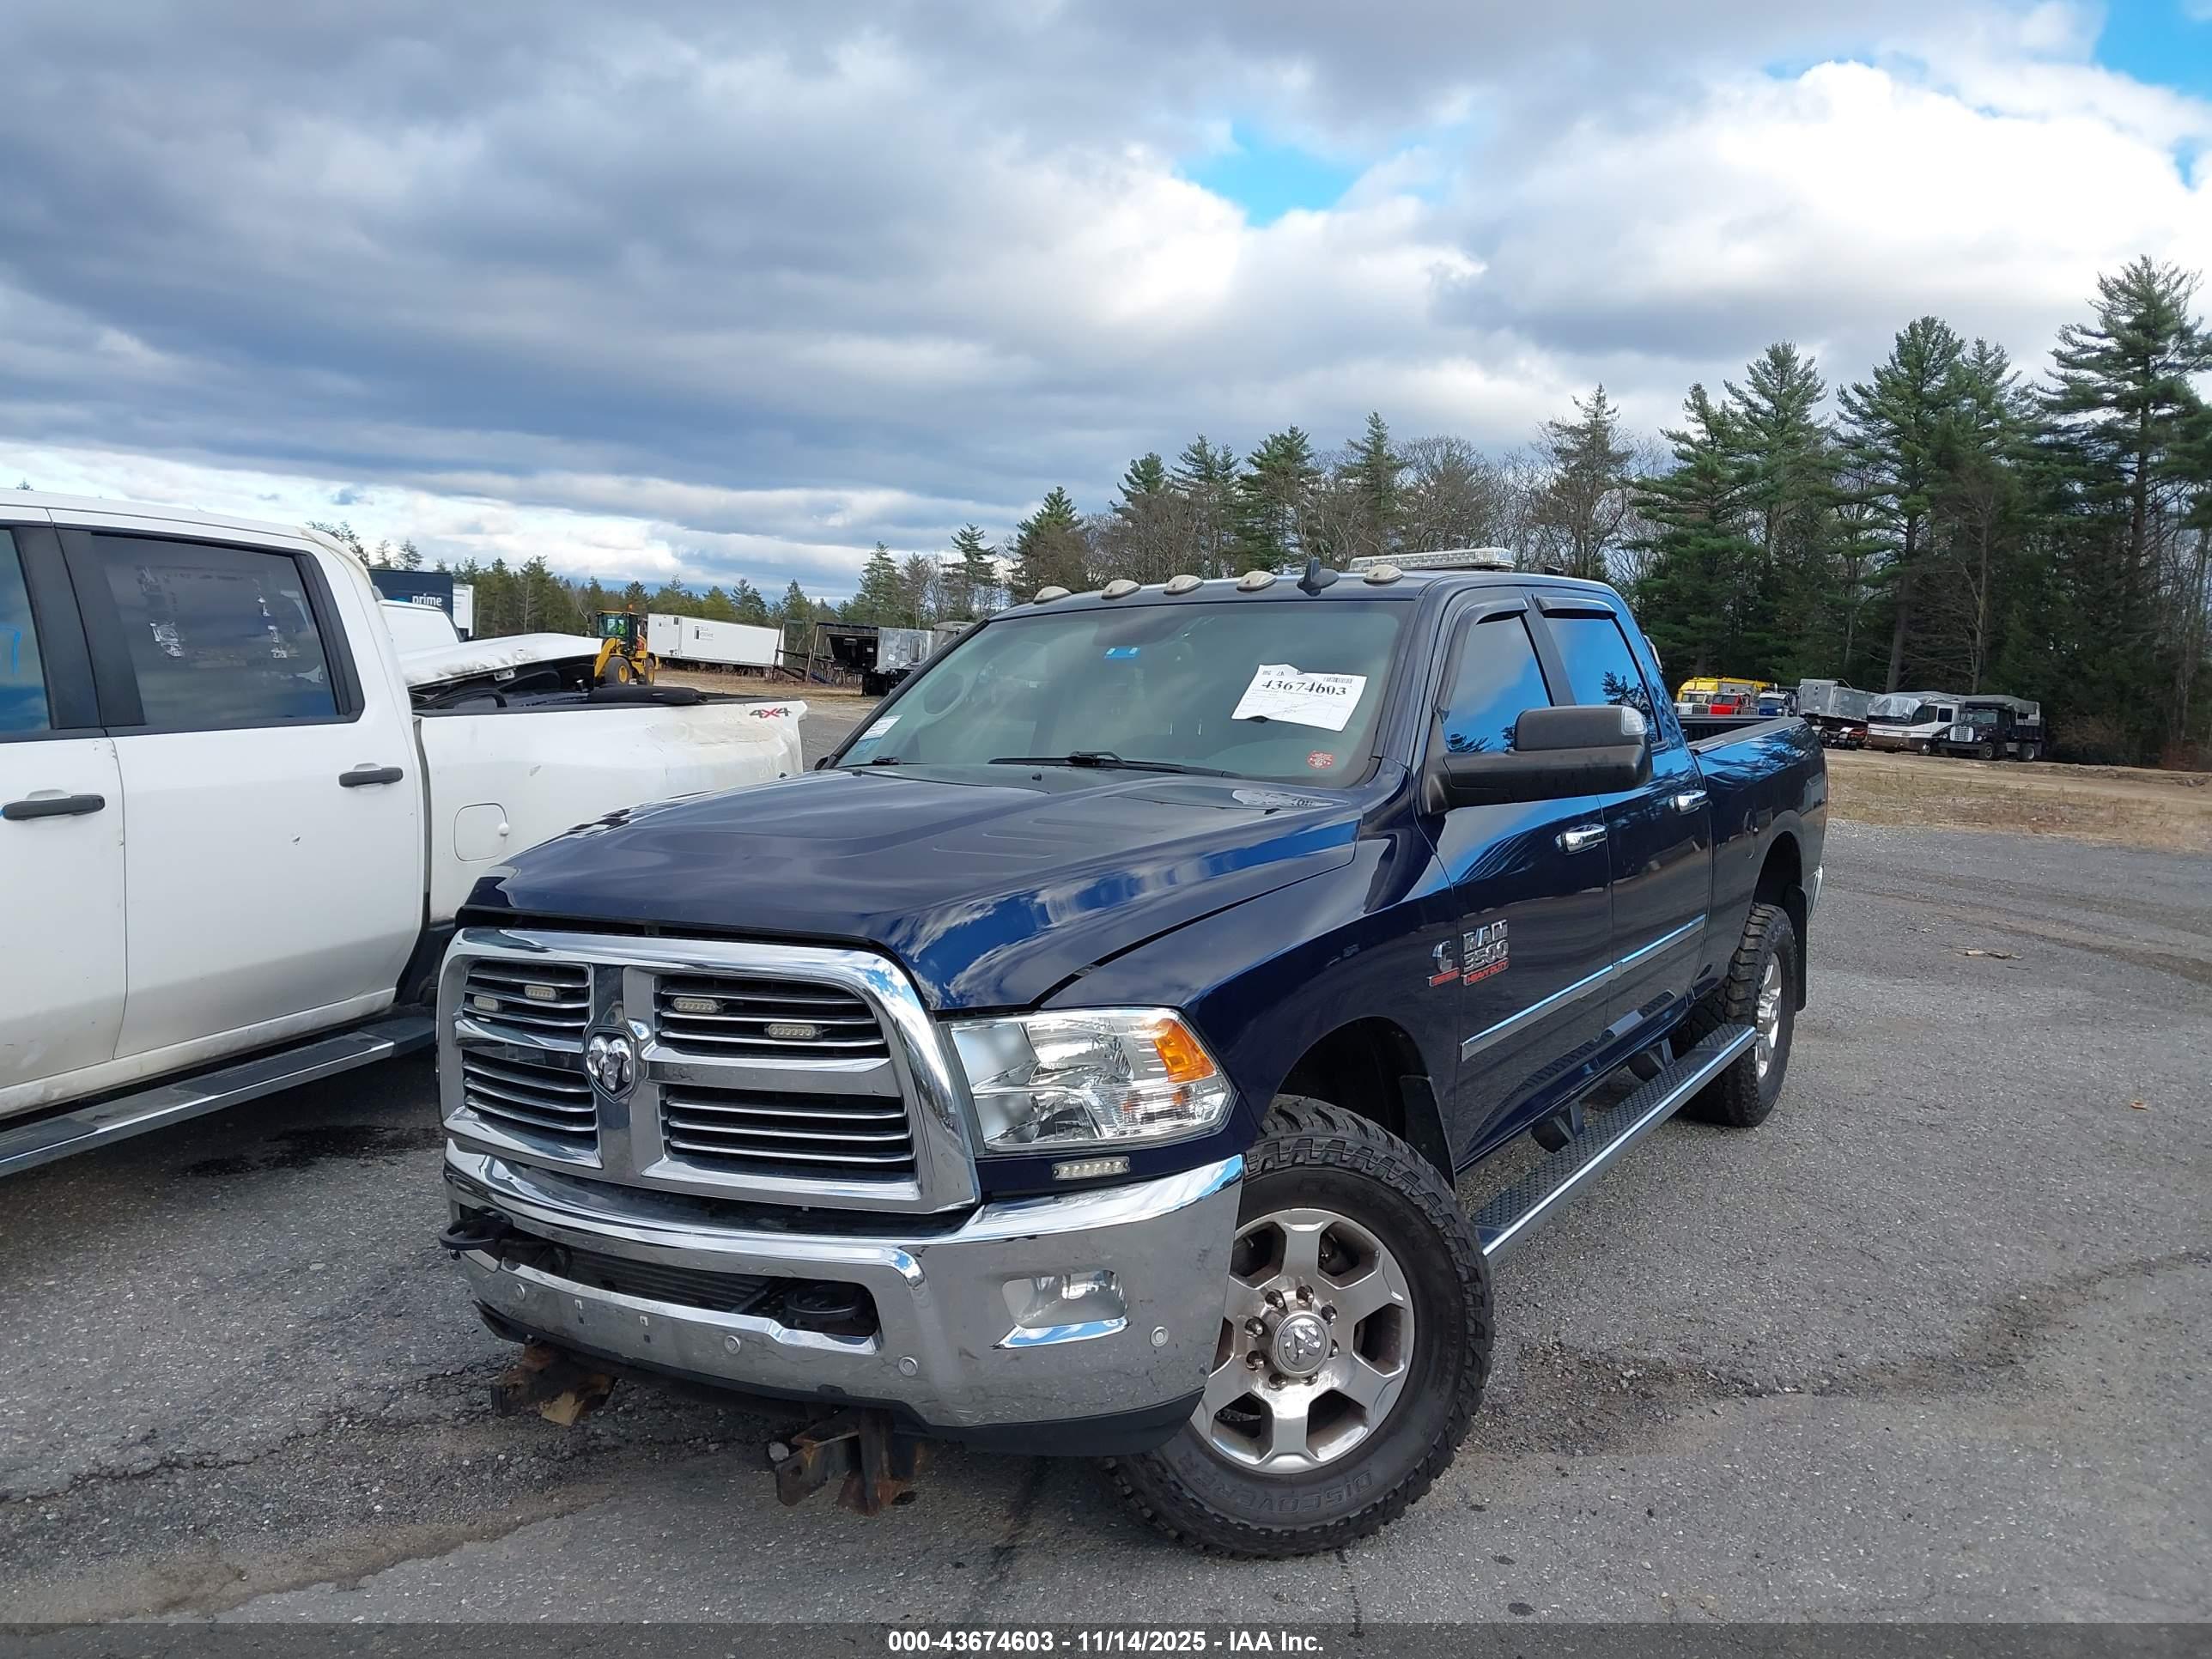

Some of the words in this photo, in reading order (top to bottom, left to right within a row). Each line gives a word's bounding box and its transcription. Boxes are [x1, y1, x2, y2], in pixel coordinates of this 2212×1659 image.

[412, 592, 442, 606] prime
[1261, 679, 1347, 696] 43674603
[1462, 919, 1509, 953] RAM
